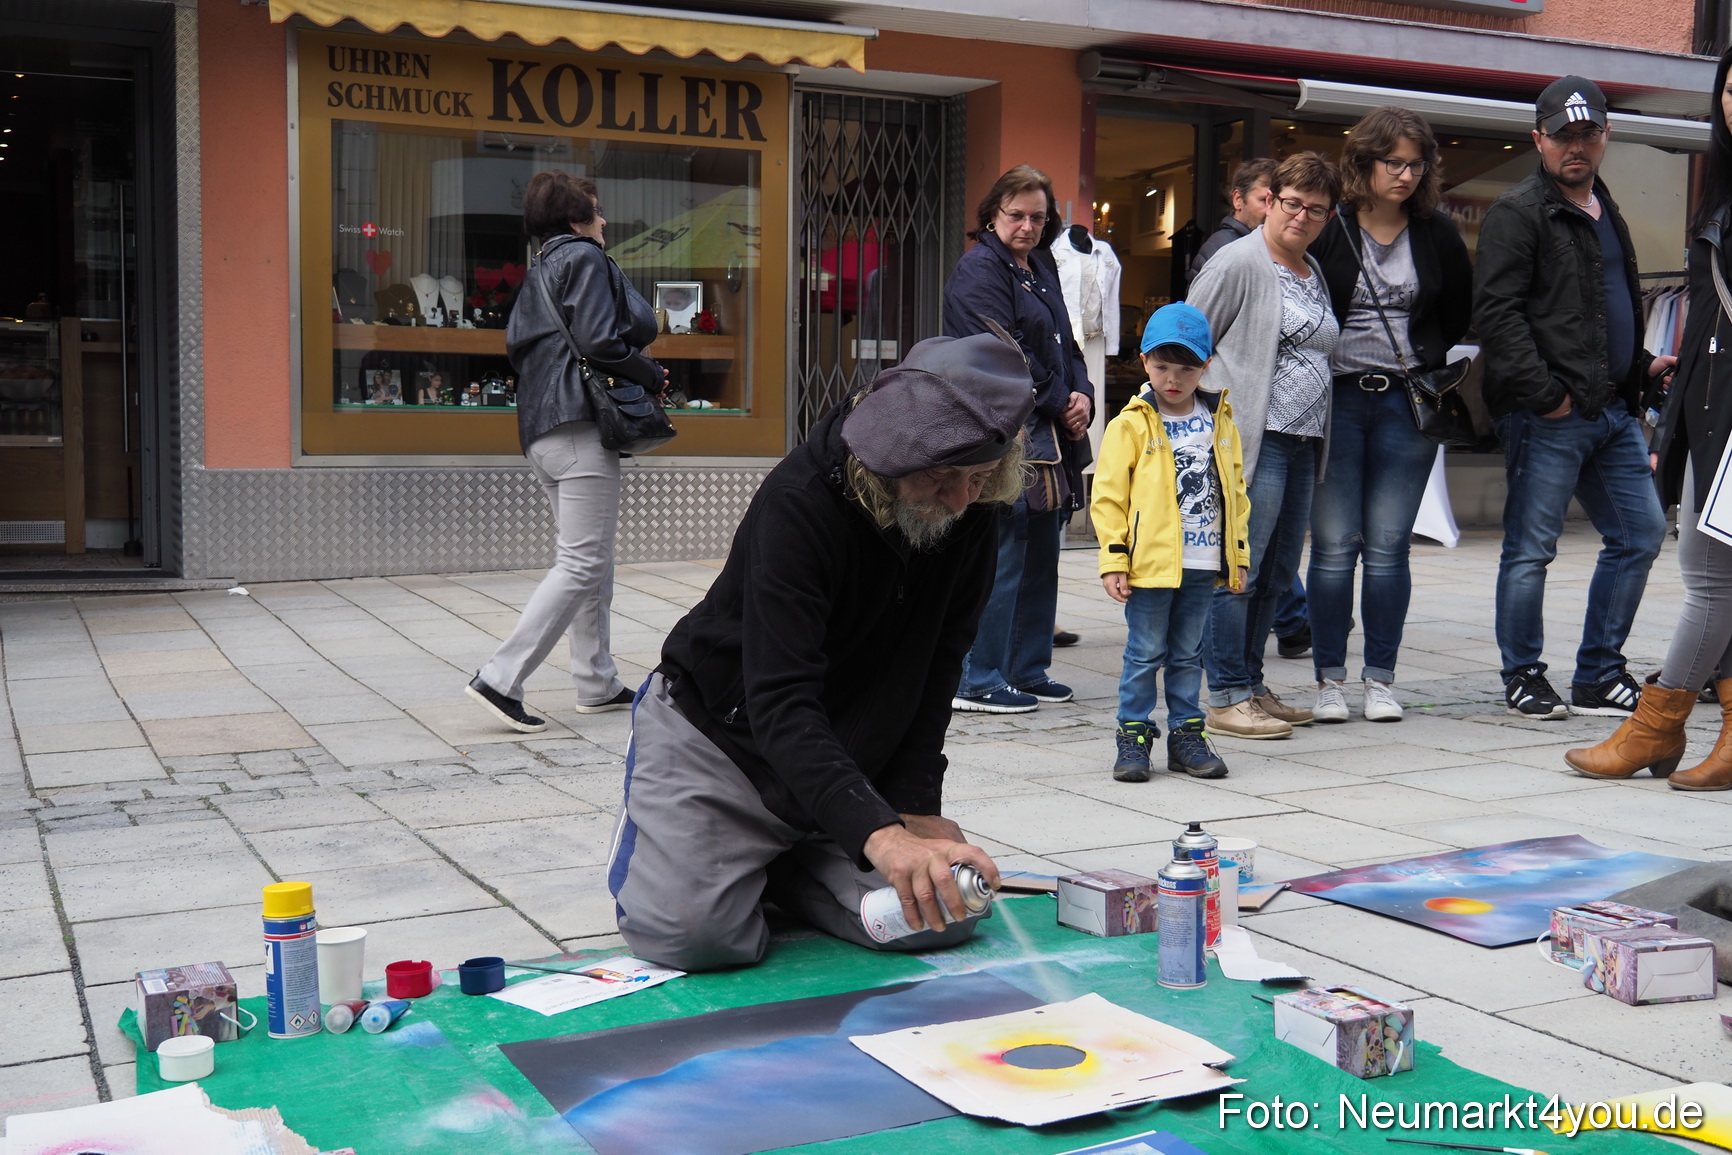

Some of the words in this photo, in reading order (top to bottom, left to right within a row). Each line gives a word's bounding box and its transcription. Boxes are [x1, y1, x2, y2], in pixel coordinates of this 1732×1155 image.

[327, 45, 431, 80] UHREN
[327, 81, 474, 118] SCHMUCK
[487, 57, 768, 142] KOLLER
[339, 224, 361, 234] Swiss
[378, 226, 405, 237] Watch
